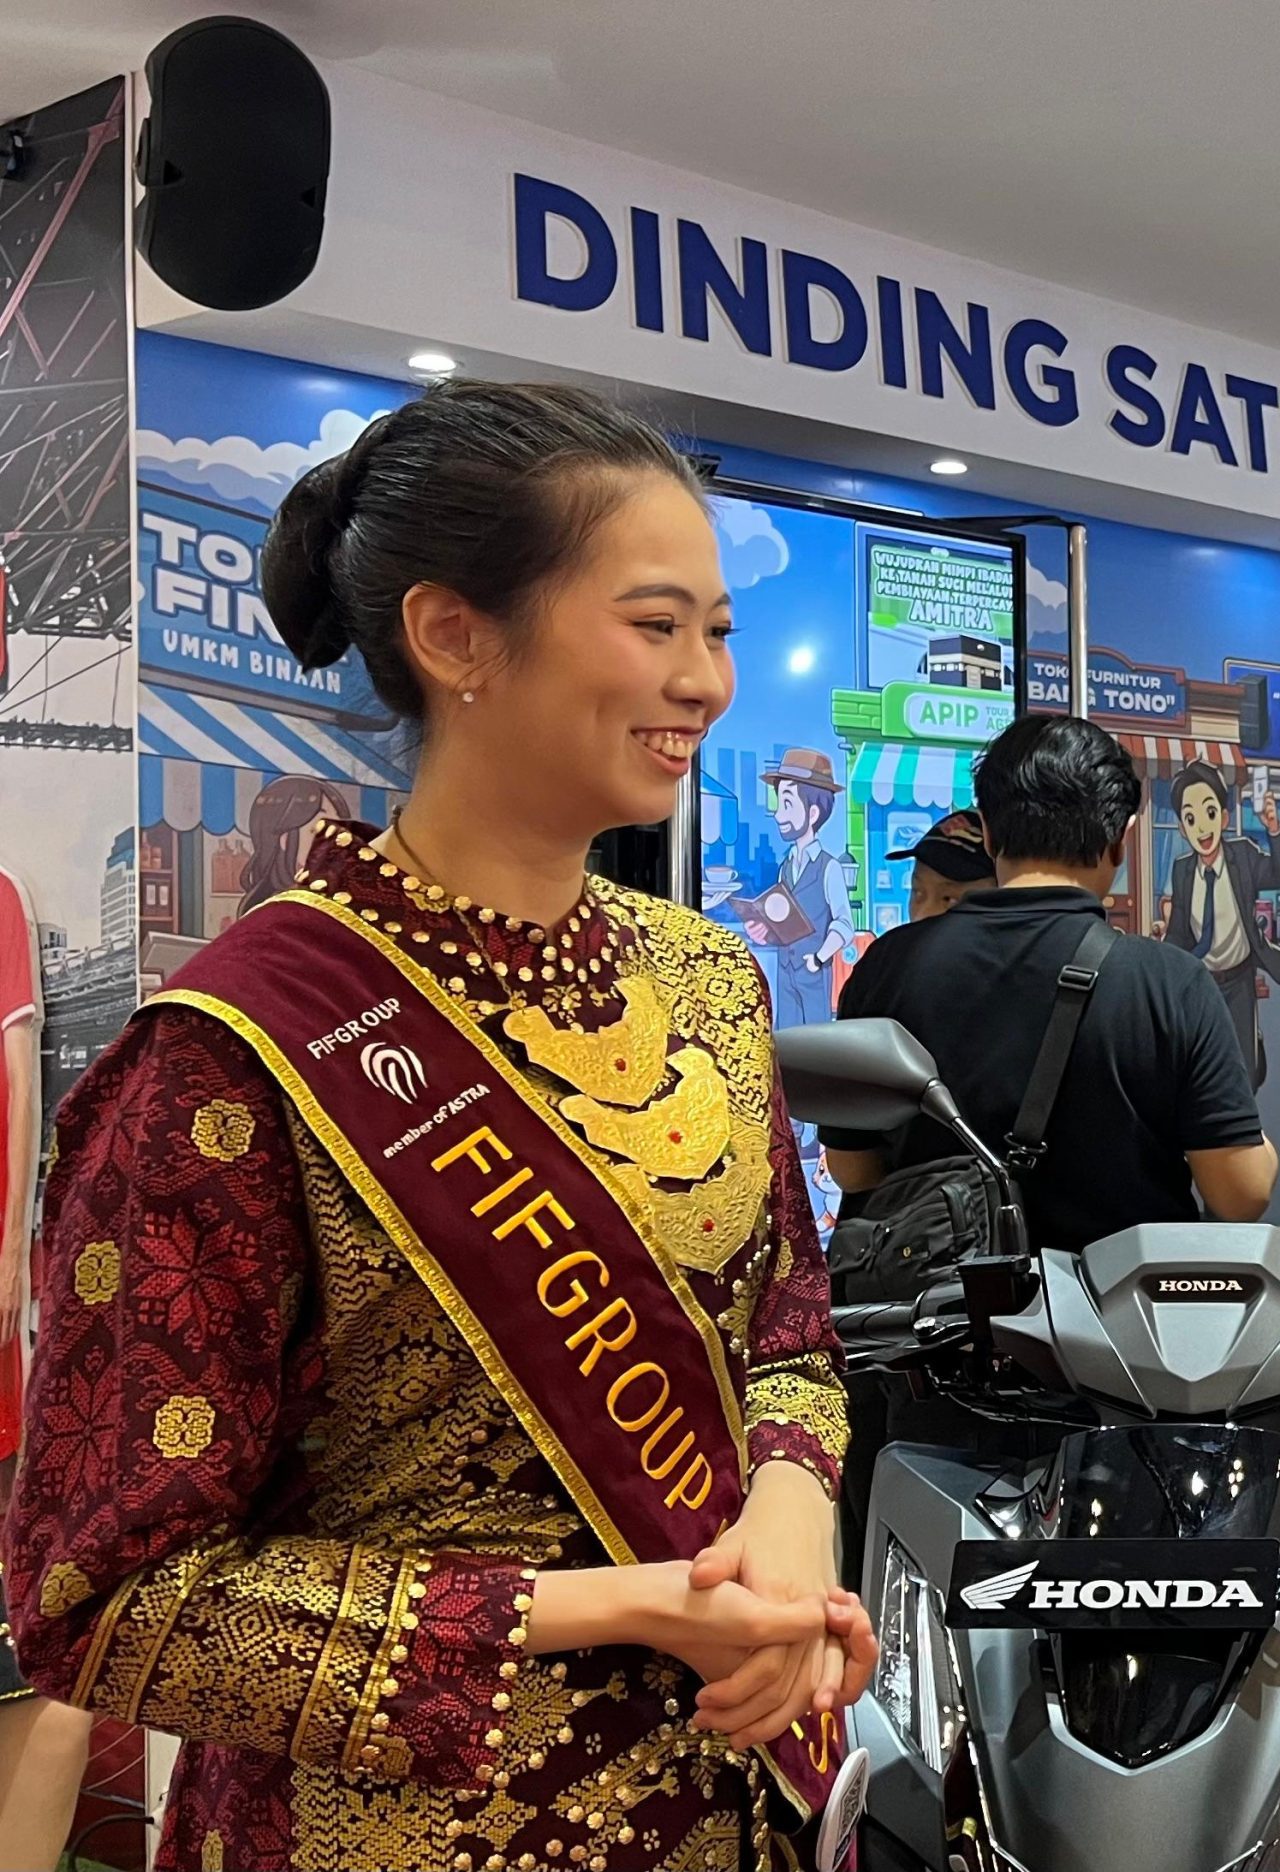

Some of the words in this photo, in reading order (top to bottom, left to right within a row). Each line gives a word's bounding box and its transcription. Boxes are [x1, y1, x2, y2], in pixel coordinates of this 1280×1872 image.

[513, 171, 1080, 428] DINDING
[874, 551, 940, 574] WUJUDKAN
[942, 562, 976, 579] MIMPI
[880, 567, 895, 581] KE
[898, 571, 935, 588] TANAH
[938, 577, 963, 593] SUCI
[877, 580, 950, 602] PEMBIAYAAN
[910, 601, 993, 631] AMITRA
[162, 628, 239, 669] UMKM
[249, 650, 341, 694] BINAAN
[919, 700, 981, 728] APIP
[306, 997, 401, 1060] FIFGROUP
[382, 1120, 434, 1159] member
[432, 1105, 448, 1125] of
[449, 1083, 490, 1115] ASTRA
[1158, 1279, 1243, 1292] HONDA
[430, 1125, 713, 1511] FIFGROUP
[1028, 1578, 1264, 1610] HONDA
